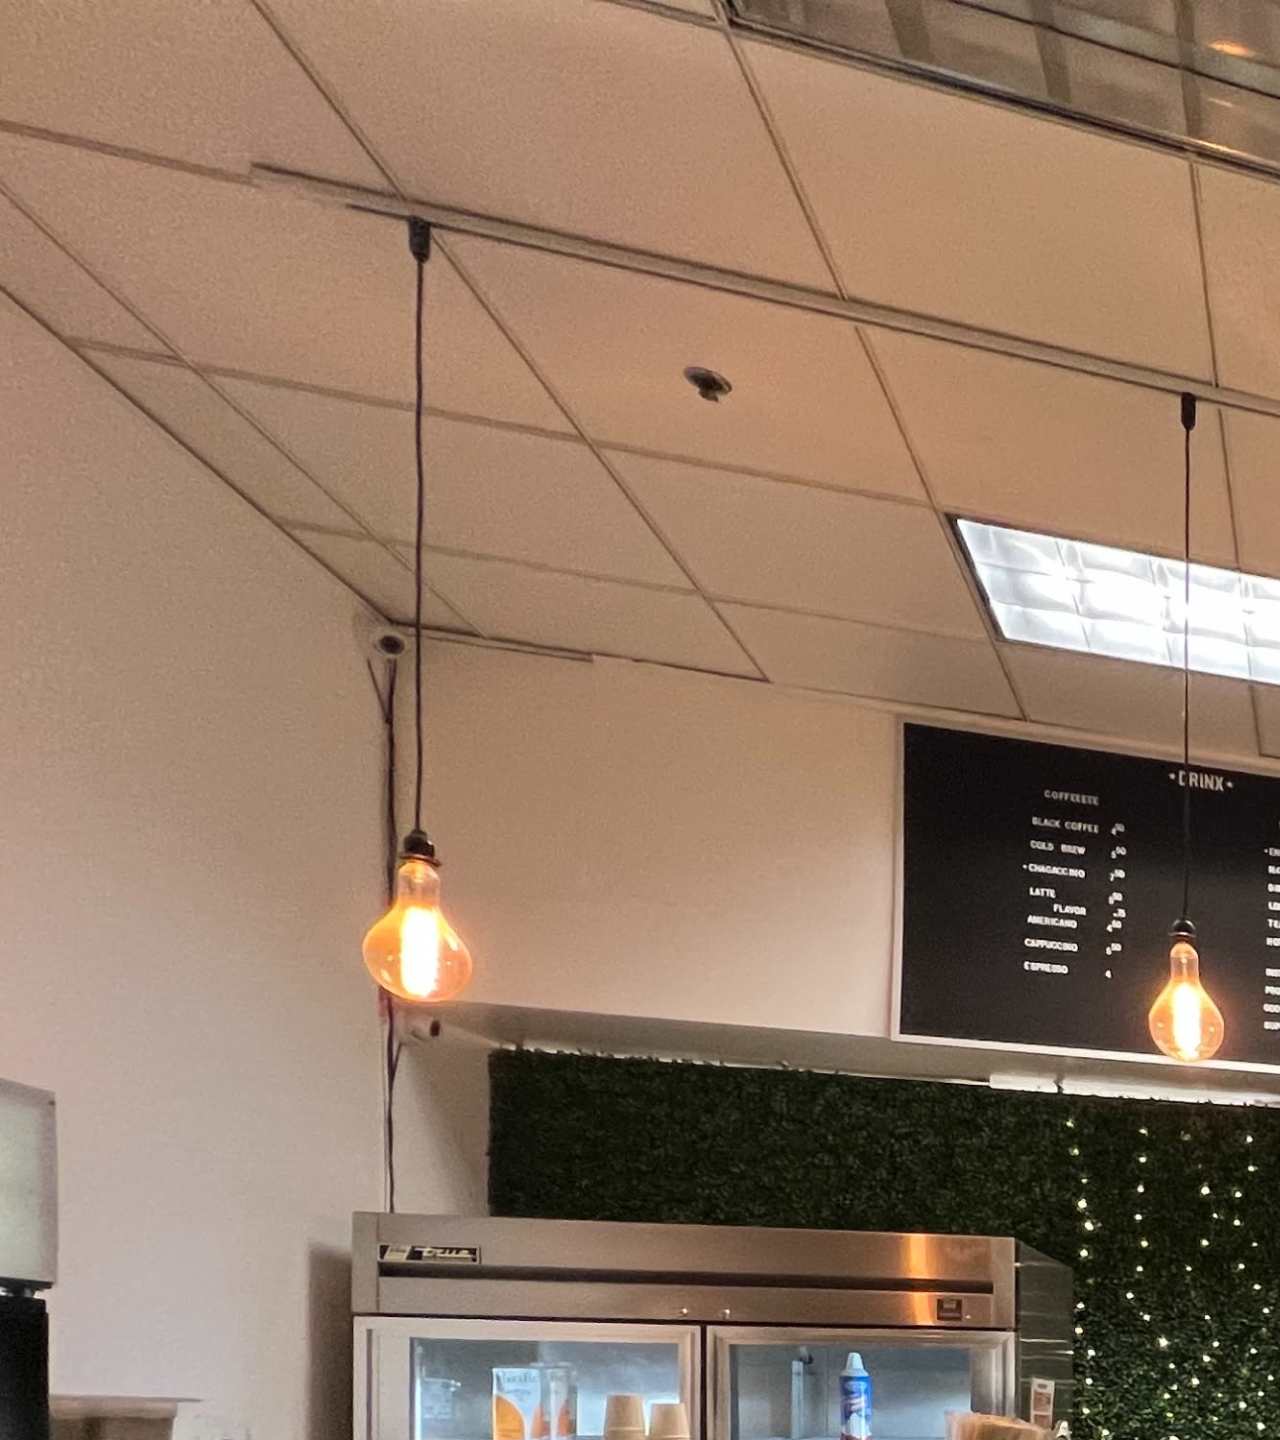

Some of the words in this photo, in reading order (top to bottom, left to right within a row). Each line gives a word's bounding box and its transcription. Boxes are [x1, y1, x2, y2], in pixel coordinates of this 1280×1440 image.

[1065, 821, 1099, 834] COFFEE
[1030, 840, 1054, 851] COLD
[1061, 844, 1085, 854] BREW
[1029, 887, 1055, 898] LATTE
[1053, 904, 1086, 915] FLAVOR
[1027, 915, 1077, 928] AMERICANO
[1024, 938, 1078, 951] CAPPUCCINO
[1024, 961, 1068, 974] ESPRESSO
